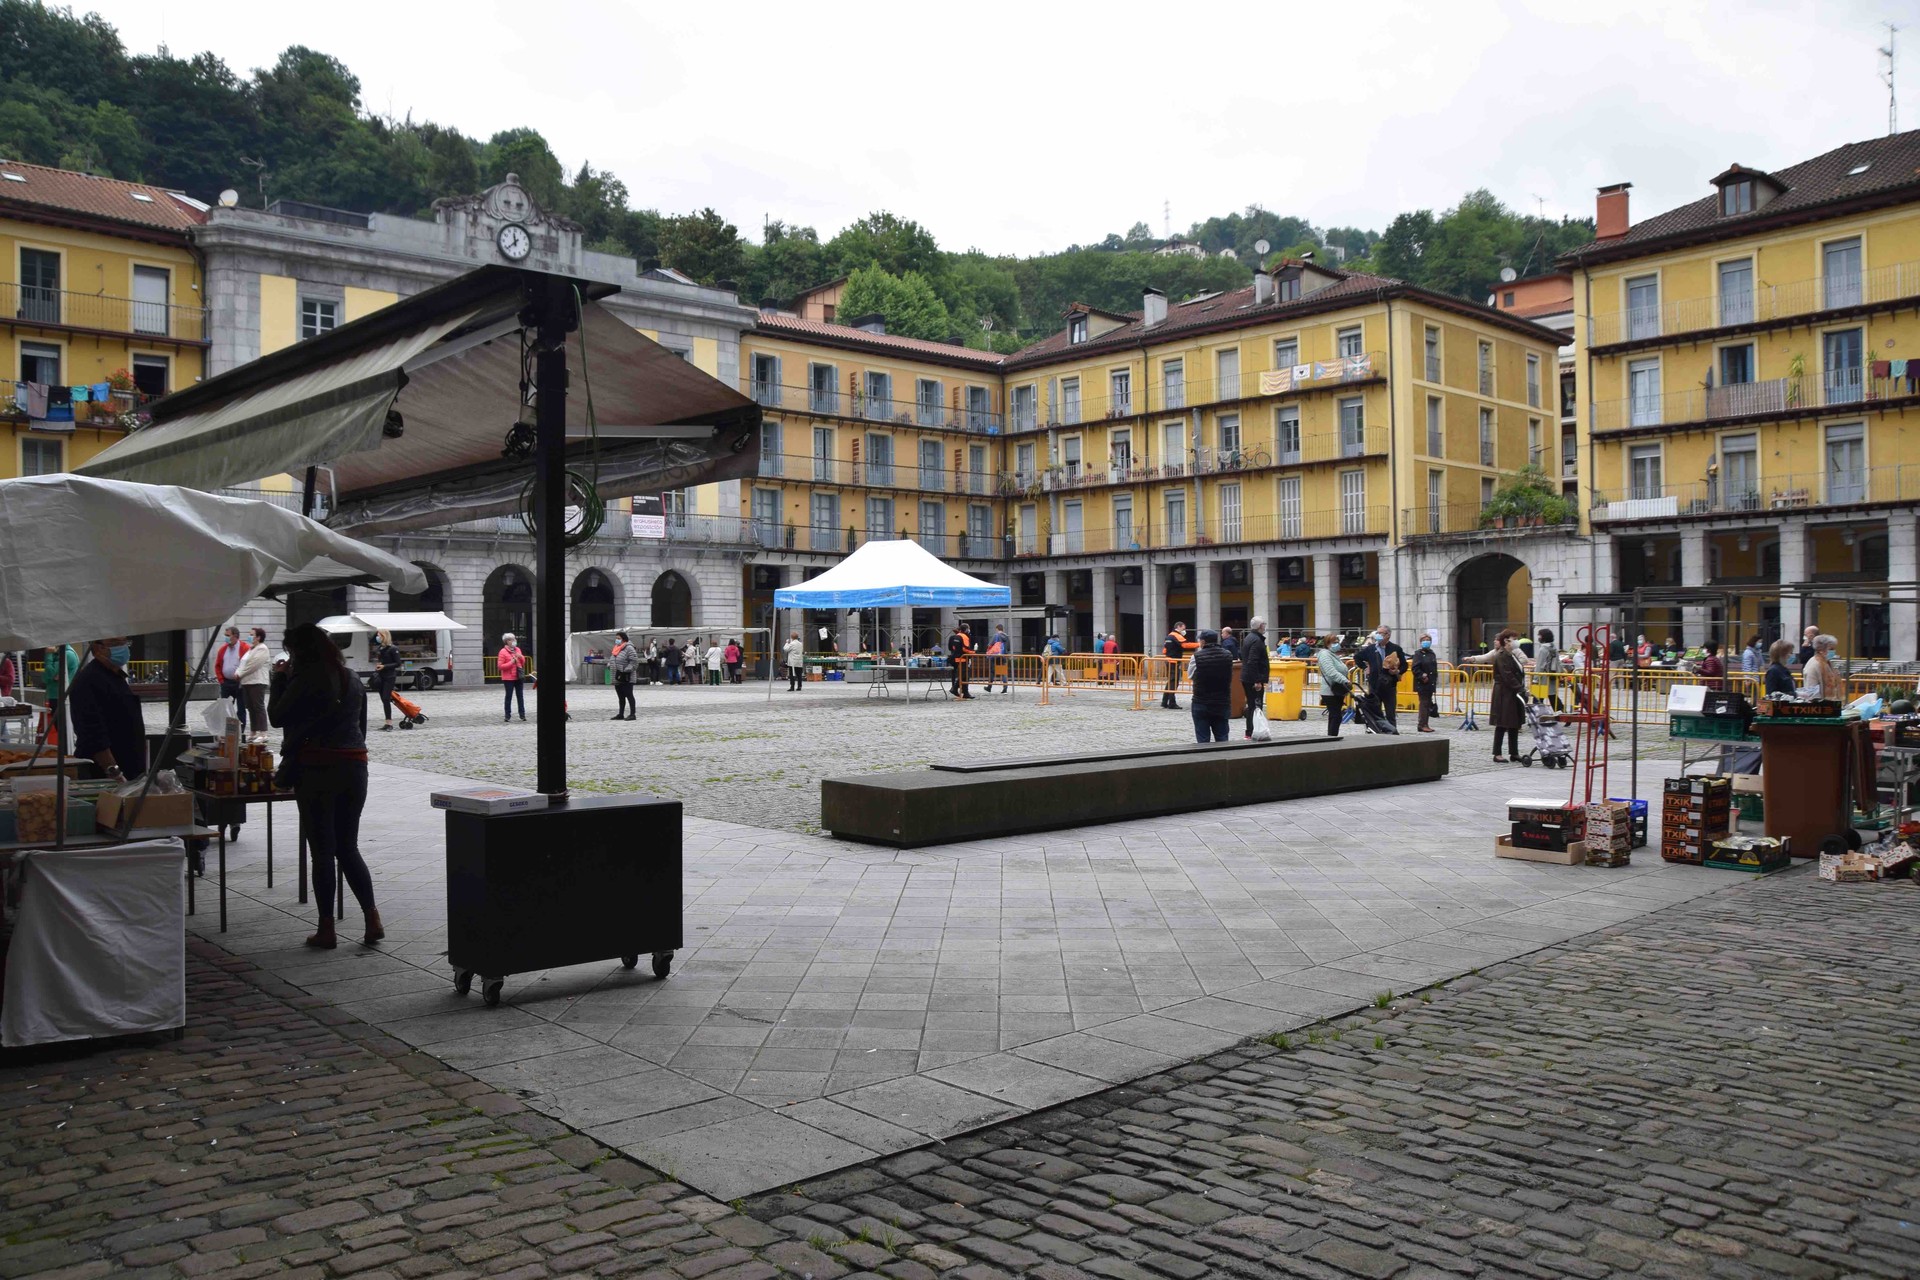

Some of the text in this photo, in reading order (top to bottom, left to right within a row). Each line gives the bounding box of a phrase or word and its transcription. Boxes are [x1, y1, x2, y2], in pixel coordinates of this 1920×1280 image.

[1793, 705, 1822, 714] TXIKI
[1666, 797, 1692, 808] TXIK
[1527, 813, 1552, 822] TXIKI
[1665, 813, 1692, 823] TXIK
[1664, 830, 1690, 840] TXIK
[1664, 846, 1691, 857] TXIK
